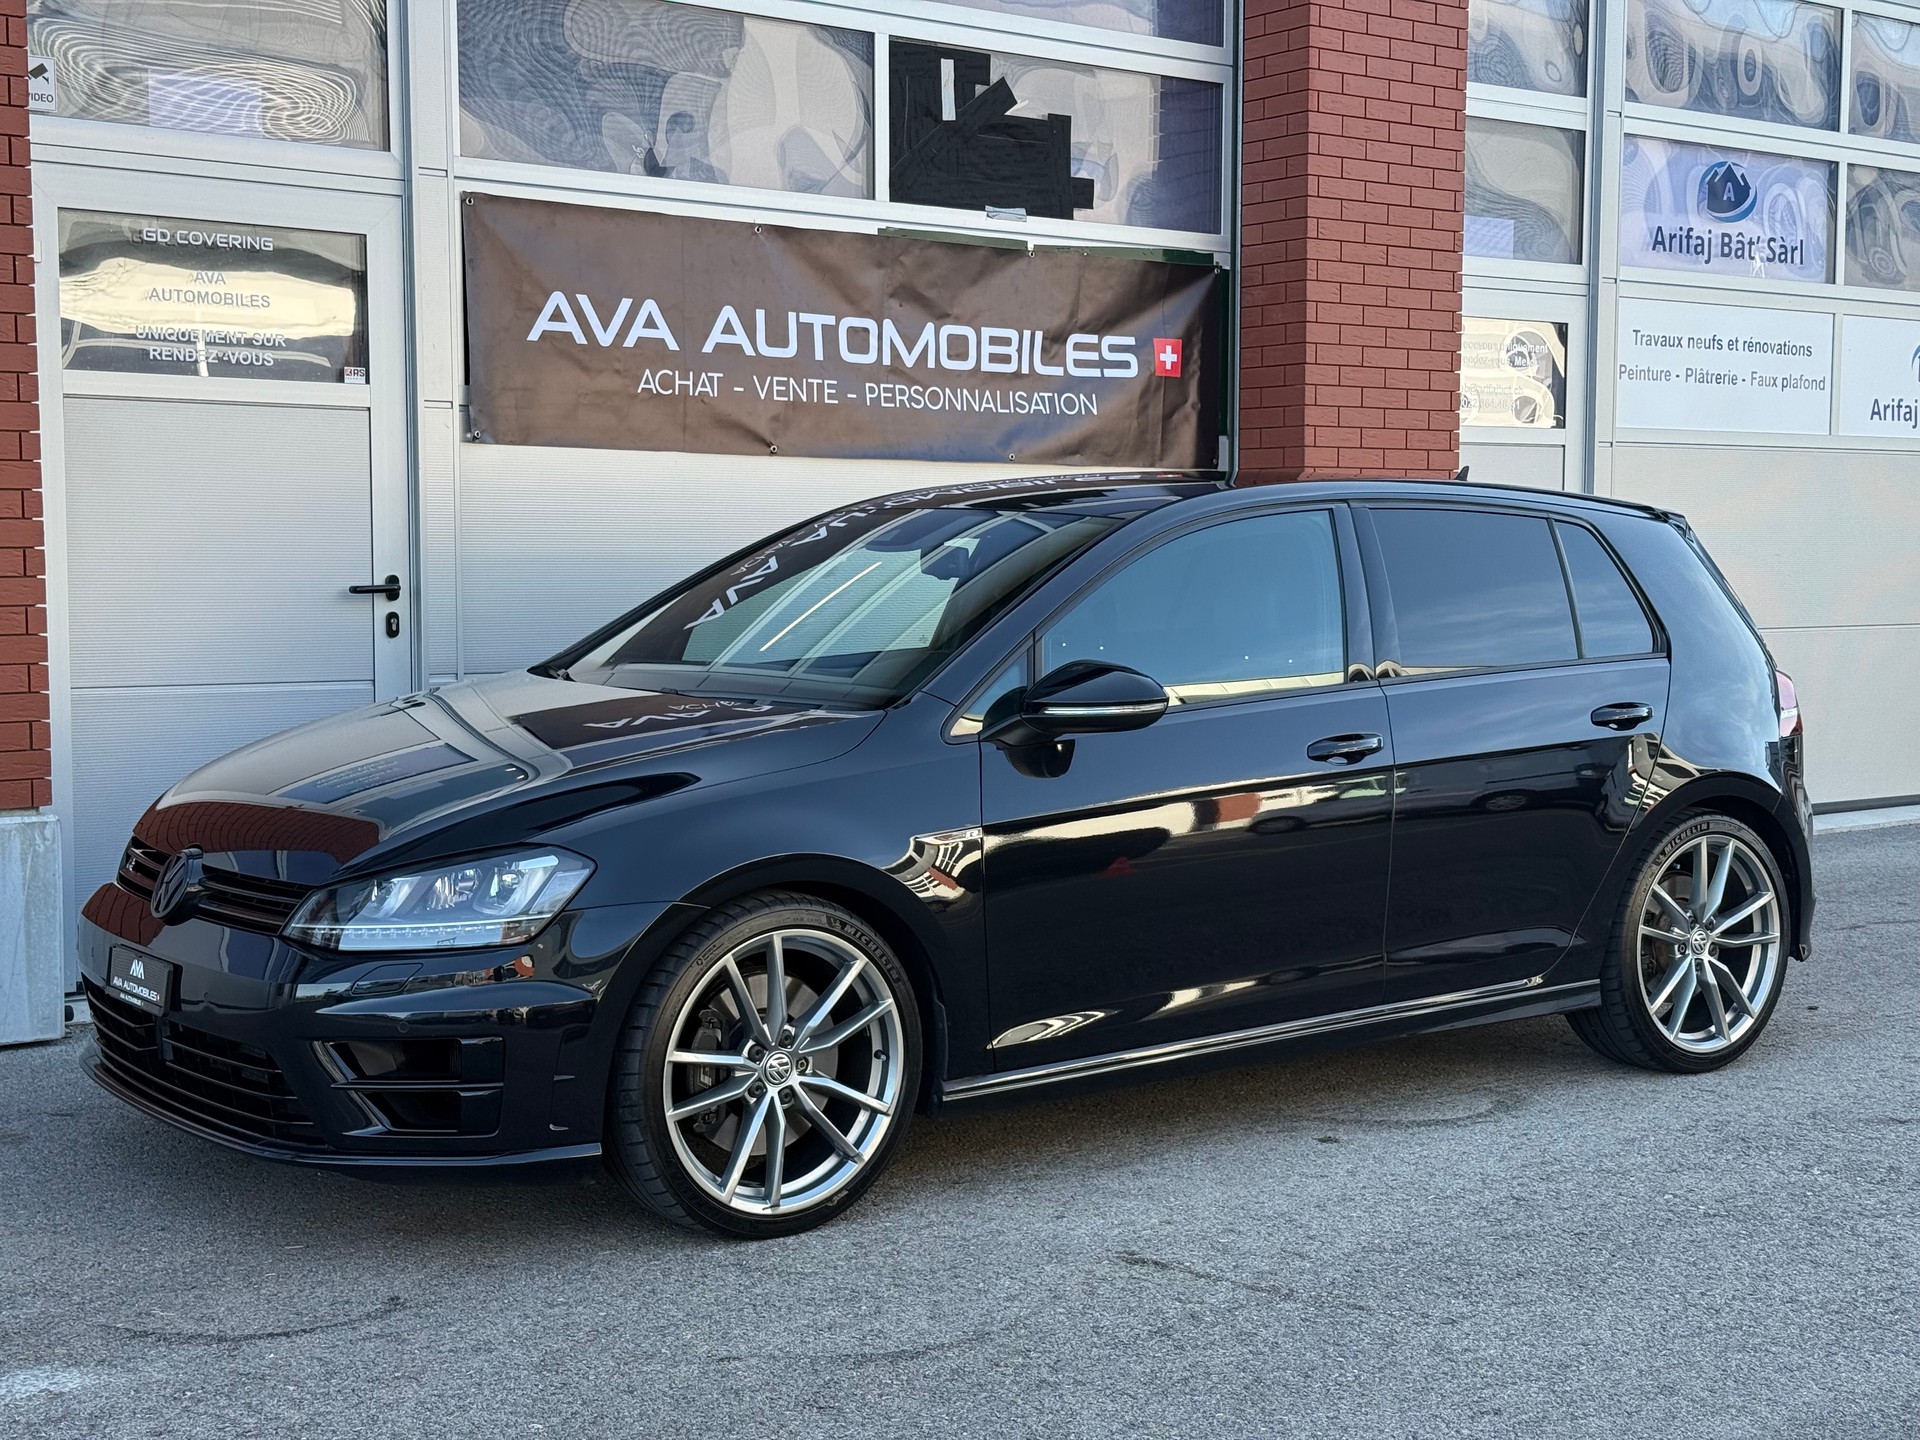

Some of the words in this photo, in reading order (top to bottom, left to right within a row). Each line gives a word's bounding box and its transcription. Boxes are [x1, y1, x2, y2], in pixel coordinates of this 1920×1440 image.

[29, 92, 54, 103] IDEO
[143, 228, 170, 242] GD
[176, 231, 274, 251] COVERING
[1652, 226, 1712, 264] Arifaj
[1766, 237, 1804, 265] Sàrl
[194, 272, 226, 285] AVA
[149, 288, 271, 308] AUTOMOBILES
[135, 324, 248, 345] UNIQUEMENT
[252, 332, 287, 347] SUR
[526, 291, 680, 351] AVA
[702, 305, 1139, 378] AUTOMOBILES
[1632, 329, 1684, 349] Travaux
[1687, 335, 1724, 351] neufs
[1727, 336, 1740, 351] et
[1742, 337, 1813, 357] rénovations
[637, 368, 724, 398] ACHAT
[752, 375, 839, 405] VENTE
[864, 382, 1099, 416] PERSONNALISATION
[1618, 364, 1672, 382] Peinture
[1685, 367, 1738, 386] Plâtrerie
[1750, 371, 1778, 388] Faux
[1781, 373, 1826, 392] plafond
[1869, 398, 1918, 430] Arifaj
[1664, 822, 1709, 855] MICHELIN
[844, 924, 900, 980] MICHELIN
